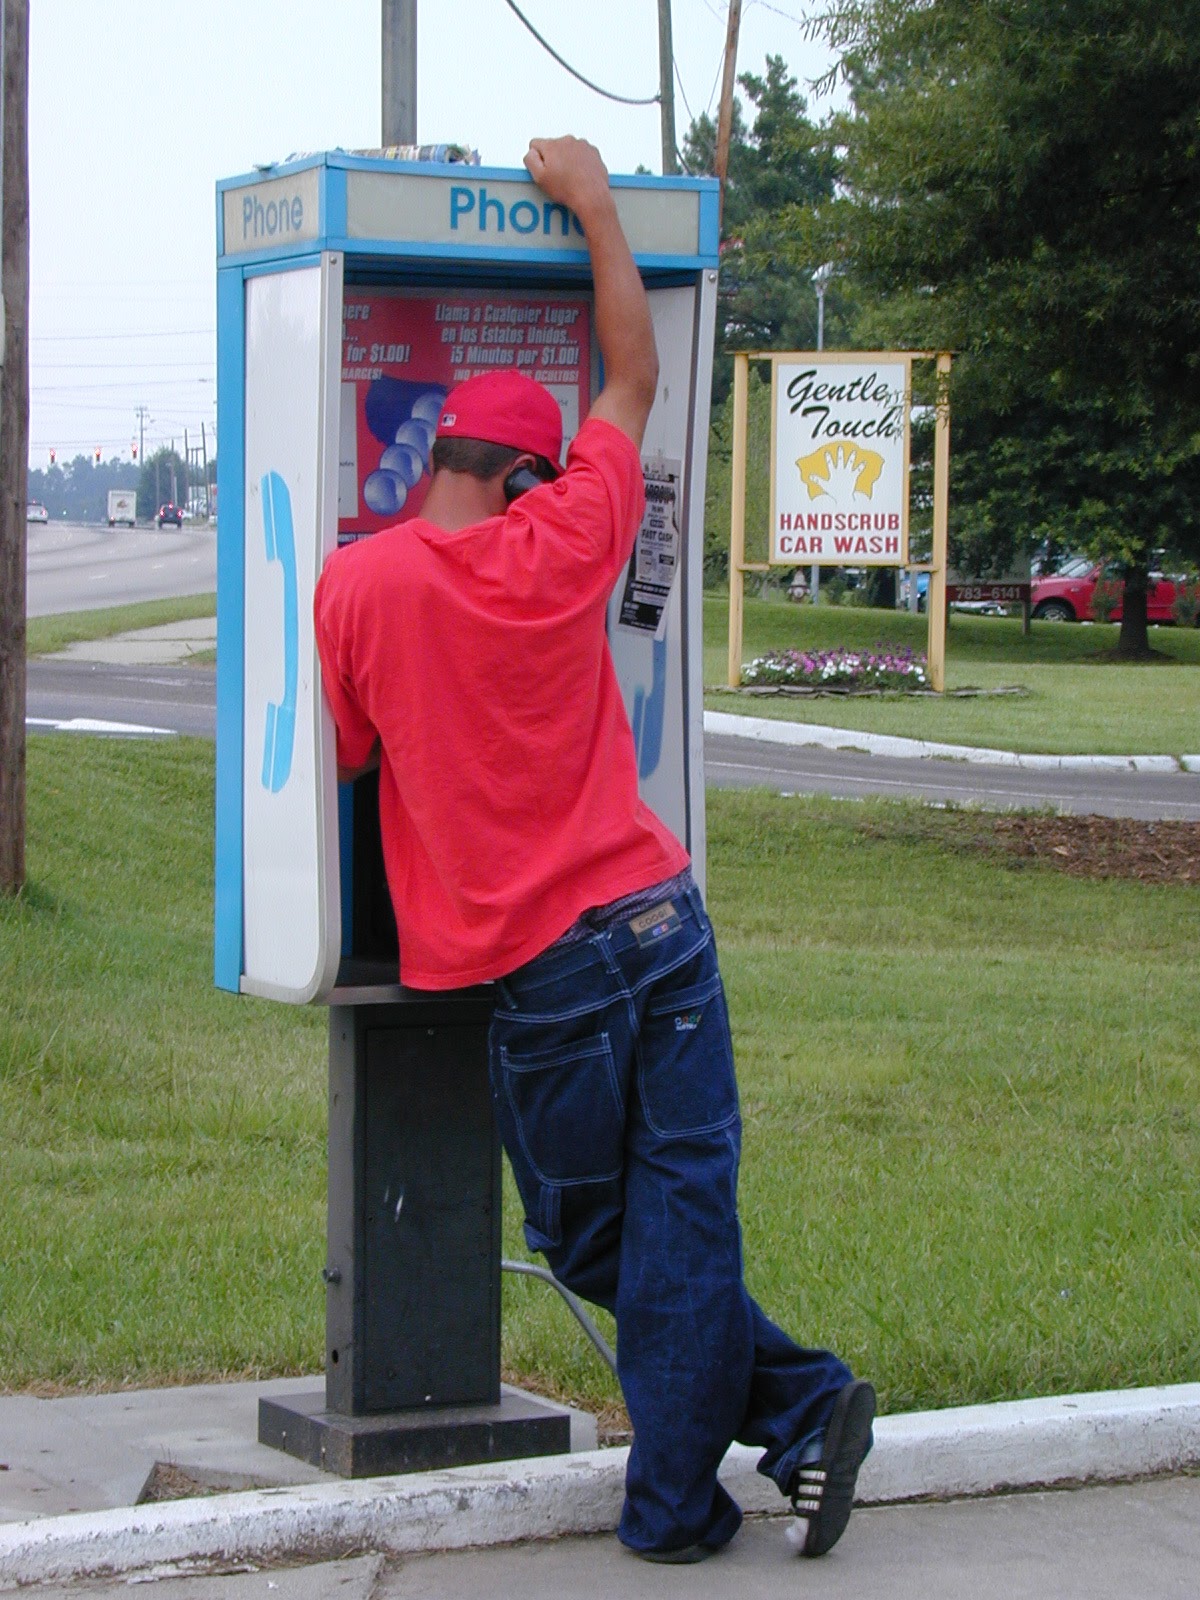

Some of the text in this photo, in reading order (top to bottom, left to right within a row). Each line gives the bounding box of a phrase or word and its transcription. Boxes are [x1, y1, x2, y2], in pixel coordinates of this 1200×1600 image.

[243, 195, 303, 240] Phone
[435, 304, 579, 325] Llama a Cualquier Lugar
[441, 327, 456, 343] en
[460, 326, 478, 343] los
[347, 343, 411, 363] for $1.00!
[466, 346, 514, 364] Minutos
[517, 349, 538, 367] por
[541, 346, 579, 366] $1.00!
[787, 369, 889, 414] Gentle
[801, 405, 901, 440] Touch
[780, 513, 900, 531] HANDSCRUB
[780, 536, 899, 554] CAR WASH
[956, 587, 1020, 600] 783-6141
